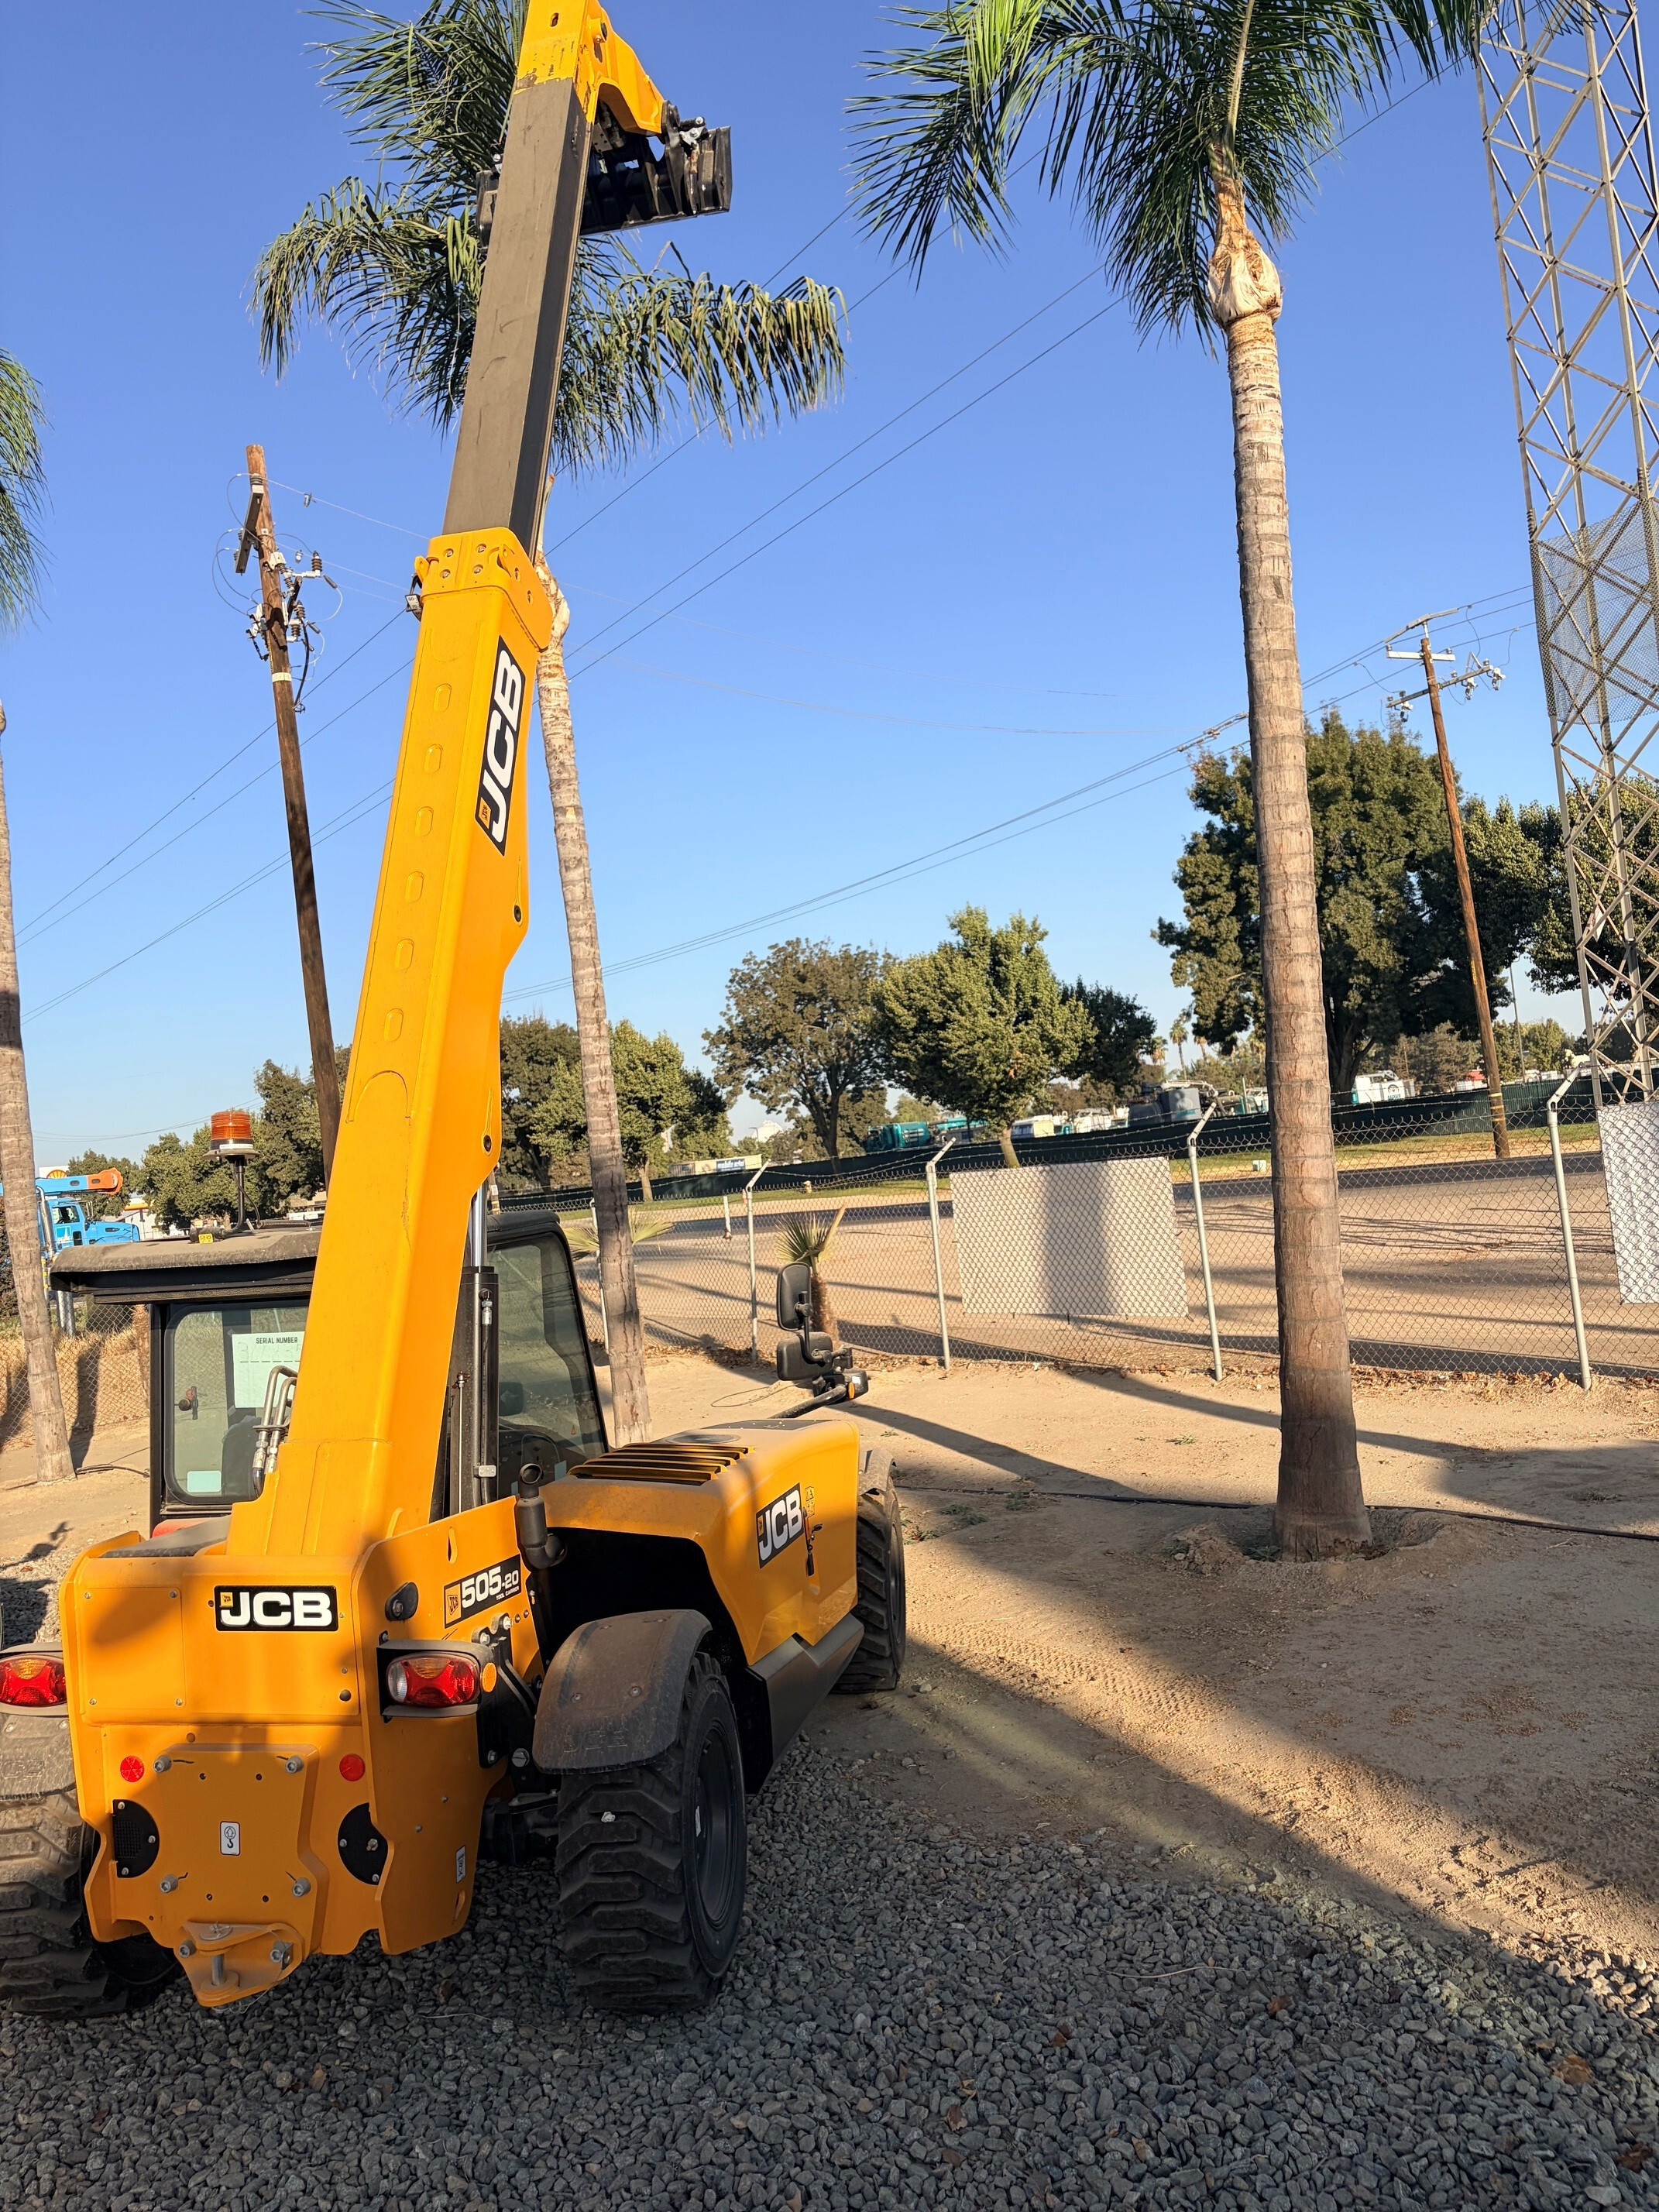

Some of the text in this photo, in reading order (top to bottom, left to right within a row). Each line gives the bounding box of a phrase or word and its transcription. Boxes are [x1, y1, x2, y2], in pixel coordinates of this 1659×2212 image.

[483, 650, 522, 843] JCB
[759, 1489, 802, 1561] JCB
[221, 1592, 333, 1627] JCB
